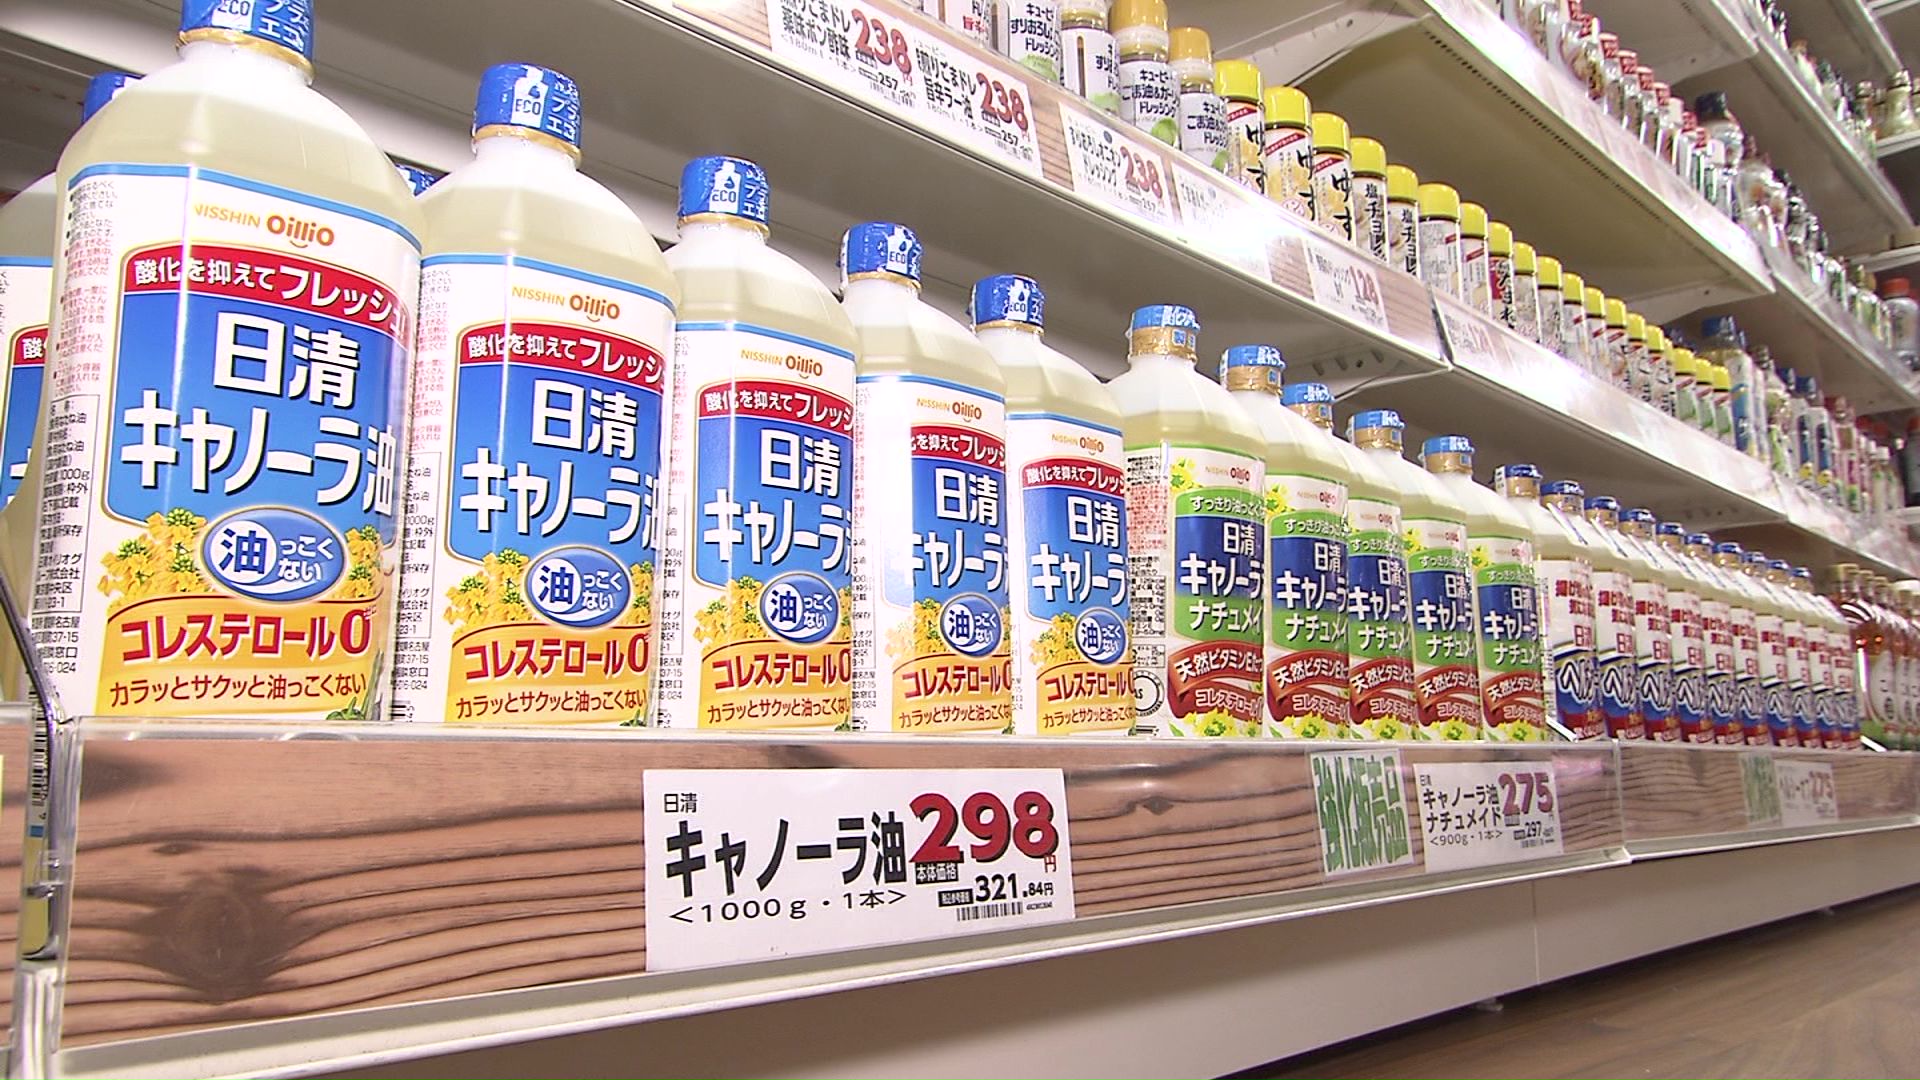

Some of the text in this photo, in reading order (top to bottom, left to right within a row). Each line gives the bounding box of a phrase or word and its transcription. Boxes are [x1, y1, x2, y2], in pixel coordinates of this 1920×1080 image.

[852, 8, 912, 76] 238
[878, 72, 898, 91] 257
[516, 98, 541, 115] ECO
[976, 72, 1029, 132] 238
[1001, 130, 1019, 147] 257
[1120, 146, 1163, 199] 238
[712, 189, 736, 203] ECO
[194, 204, 261, 229] NISSHIN
[889, 250, 906, 265] ECO
[511, 285, 566, 306] NISSHIN
[22, 336, 46, 360] 酸
[213, 311, 361, 408] 日清
[741, 348, 784, 367] NISSHIN
[916, 397, 951, 413] NISSHIN
[531, 378, 639, 461] 日清
[120, 389, 399, 518] キャノーラ油
[760, 428, 841, 498] 日清
[935, 466, 999, 527] 日清
[703, 488, 852, 571] キャノーラ
[1067, 495, 1120, 549] 日清
[218, 519, 272, 577] 油
[279, 536, 335, 560] っこく
[1223, 521, 1256, 557] 日清
[278, 557, 323, 582] ない
[1314, 541, 1341, 573] 日清
[538, 566, 575, 606] 油
[582, 570, 623, 591] っこく
[1180, 551, 1265, 600] キャノーラ
[1378, 558, 1401, 586] 日清
[582, 591, 615, 611] ない
[1445, 574, 1470, 600] 日清
[770, 589, 797, 624] 油
[803, 593, 833, 612] っこく
[803, 612, 828, 630] ない
[948, 609, 970, 640] 油
[975, 611, 997, 629] っこく
[975, 628, 994, 644] ない
[1081, 623, 1102, 651] 油
[464, 633, 651, 682] コレステロール0
[109, 671, 368, 708] カラッとサクッと油っこくない
[664, 792, 698, 814] 日清
[1423, 783, 1500, 810] キャノーラ油
[1498, 771, 1554, 817] 275
[909, 790, 1059, 864] 298
[1426, 806, 1501, 834] ナチュメイド
[1525, 821, 1542, 838] 297
[666, 811, 908, 898] キャノーラ油
[1044, 854, 1057, 873] 円
[915, 862, 958, 884] 本体価格
